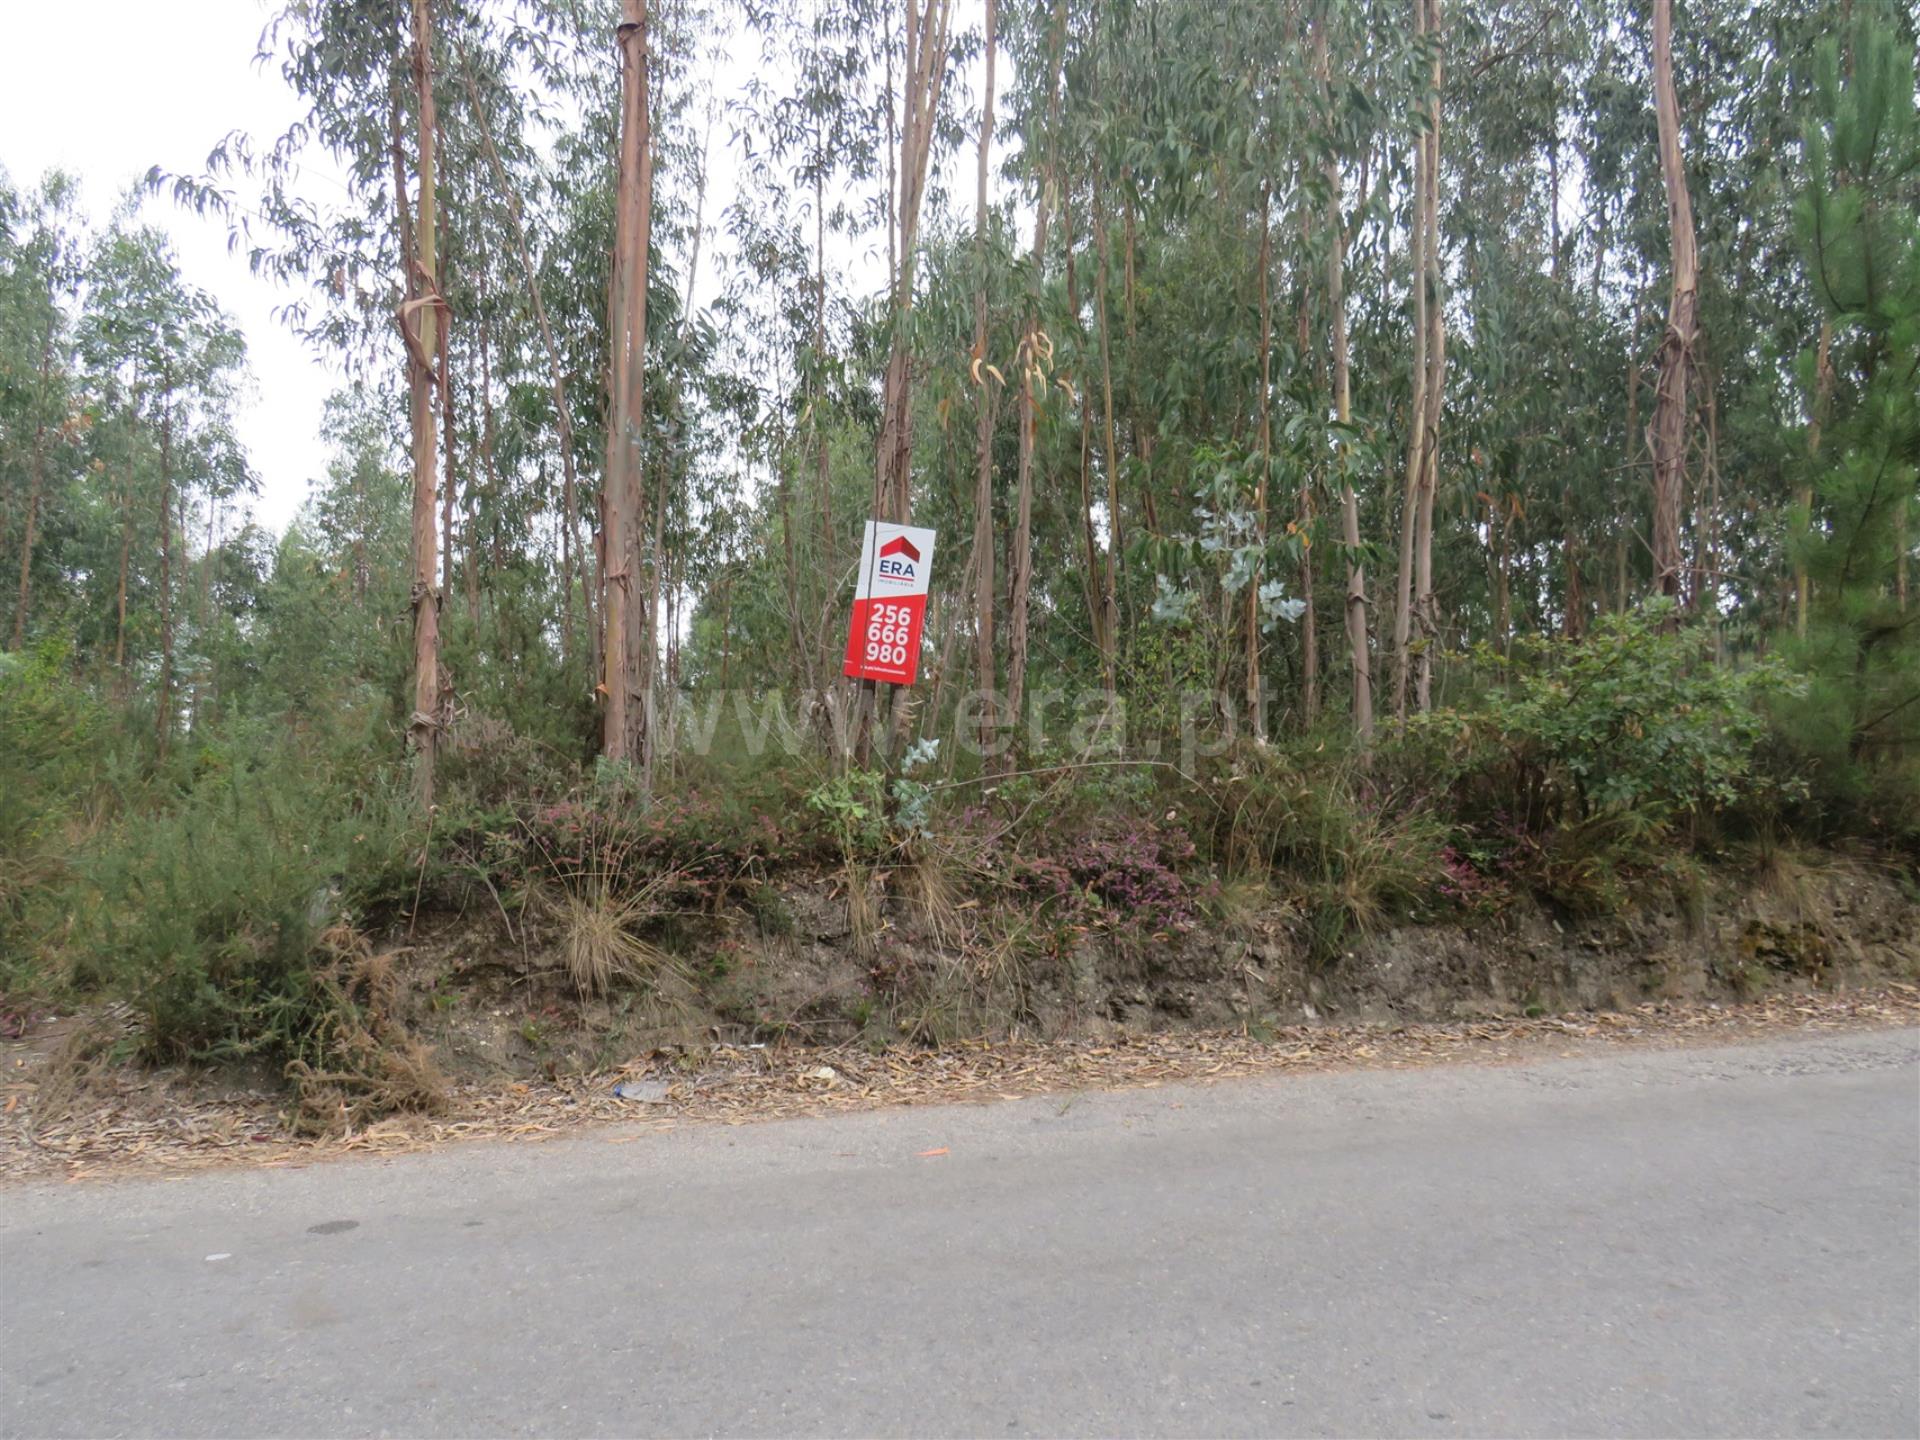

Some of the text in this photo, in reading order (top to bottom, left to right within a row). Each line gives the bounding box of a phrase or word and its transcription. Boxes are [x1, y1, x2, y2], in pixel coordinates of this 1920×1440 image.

[880, 560, 915, 577] ERA
[871, 603, 911, 625] 256
[868, 623, 909, 645] 666
[867, 643, 906, 665] 980
